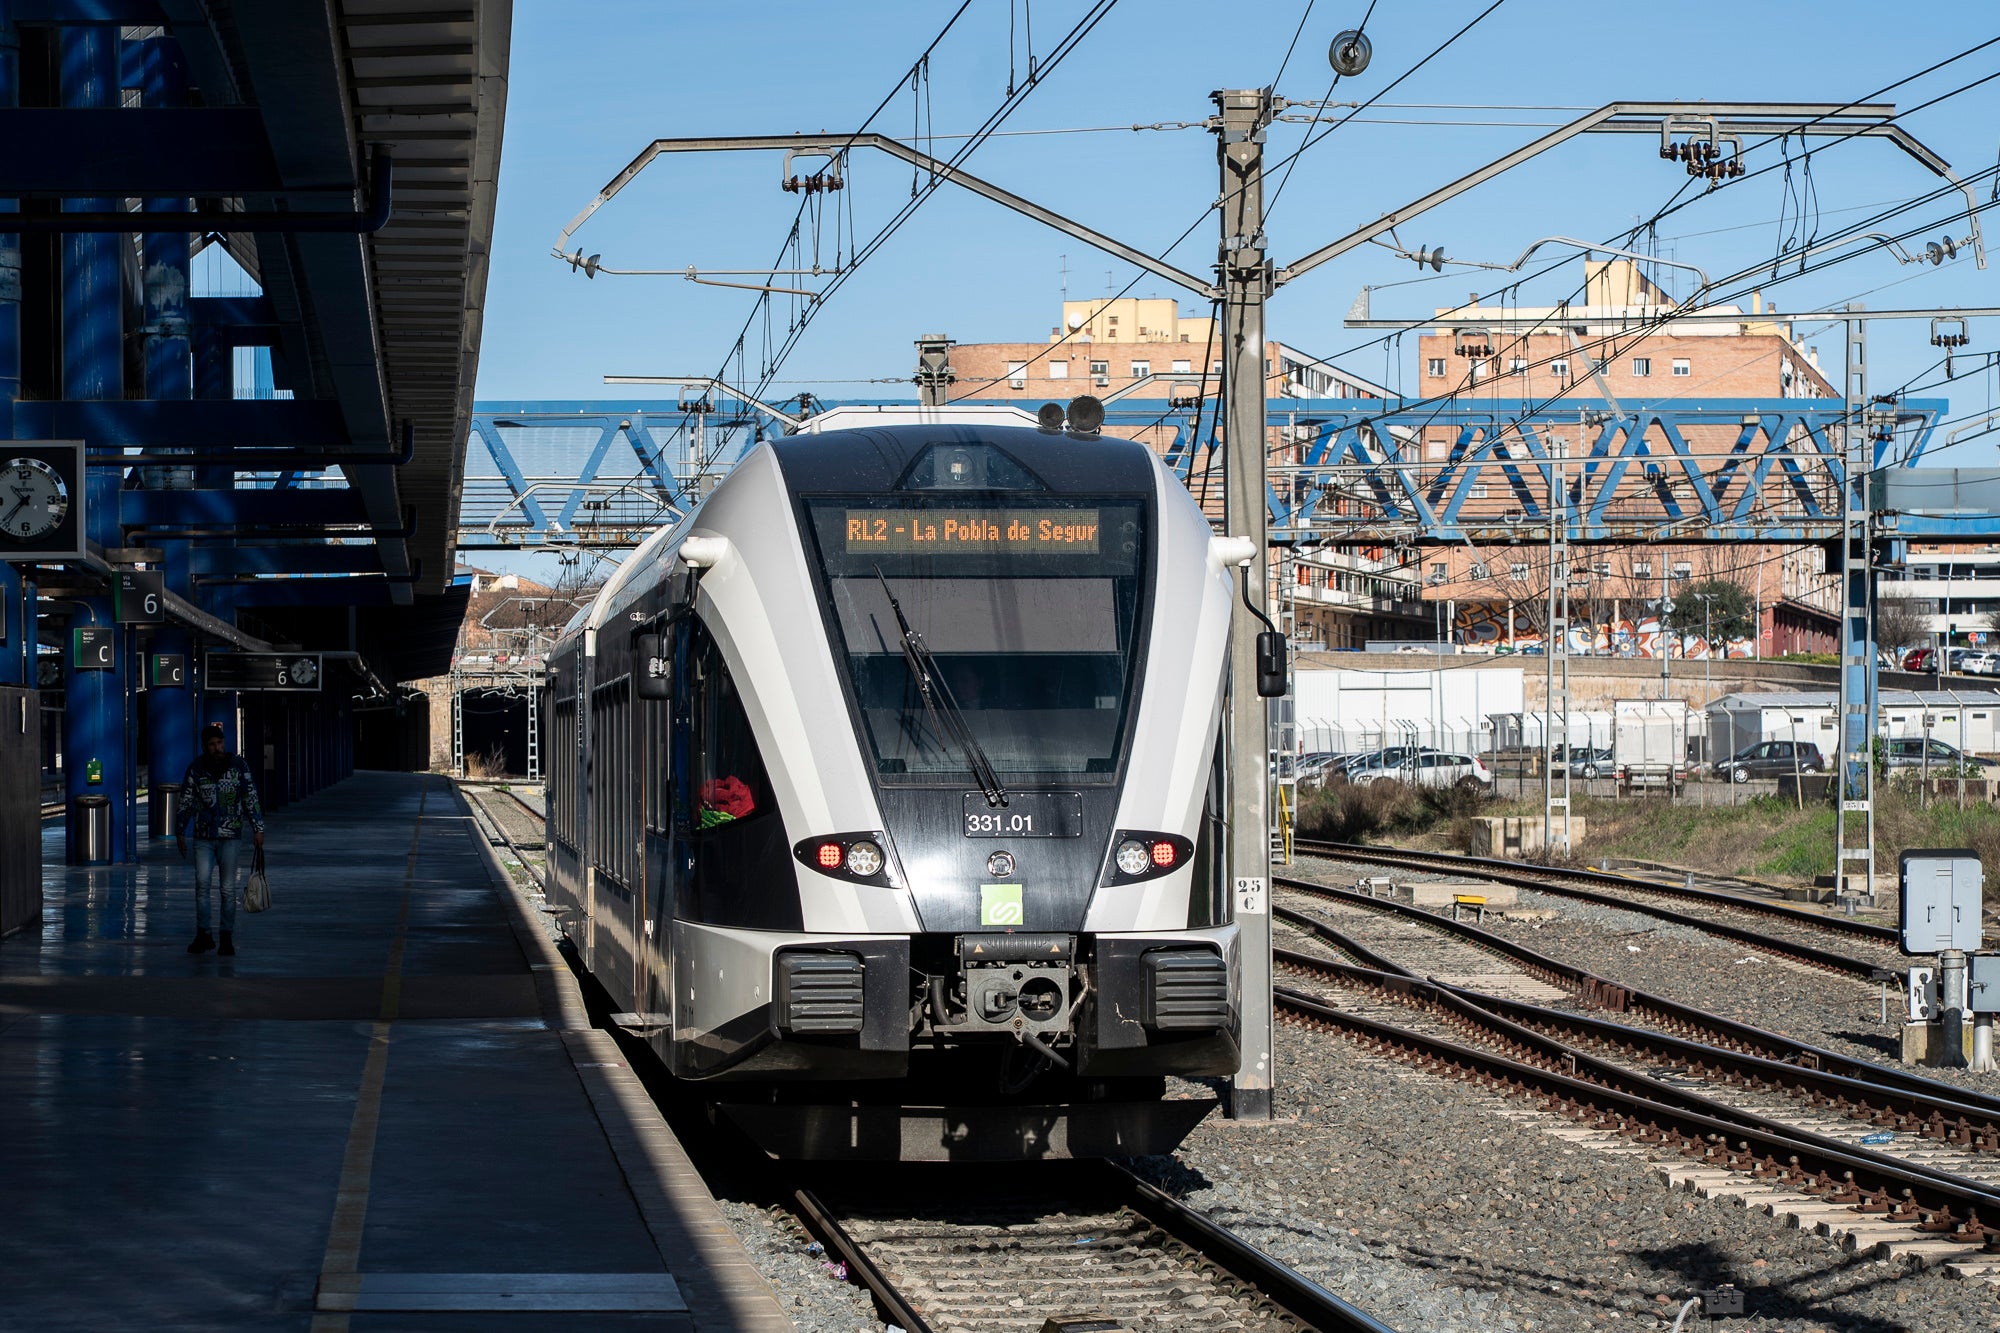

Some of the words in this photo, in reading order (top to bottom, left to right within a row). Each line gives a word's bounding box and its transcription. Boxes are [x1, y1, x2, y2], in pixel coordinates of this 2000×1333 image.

[17, 470, 32, 480] 12
[46, 495, 56, 505] 3
[20, 522, 31, 532] 6
[847, 519, 888, 542] RL2
[913, 519, 937, 542] La
[944, 519, 1000, 542] Pobla
[1007, 519, 1031, 542] de
[1038, 519, 1098, 544] Segur
[144, 593, 158, 615] 6
[98, 645, 108, 662] C
[172, 667, 180, 682] C
[278, 671, 287, 685] 6
[968, 814, 1033, 832] 331.01
[1238, 880, 1261, 893] 25
[1243, 896, 1255, 910] C
